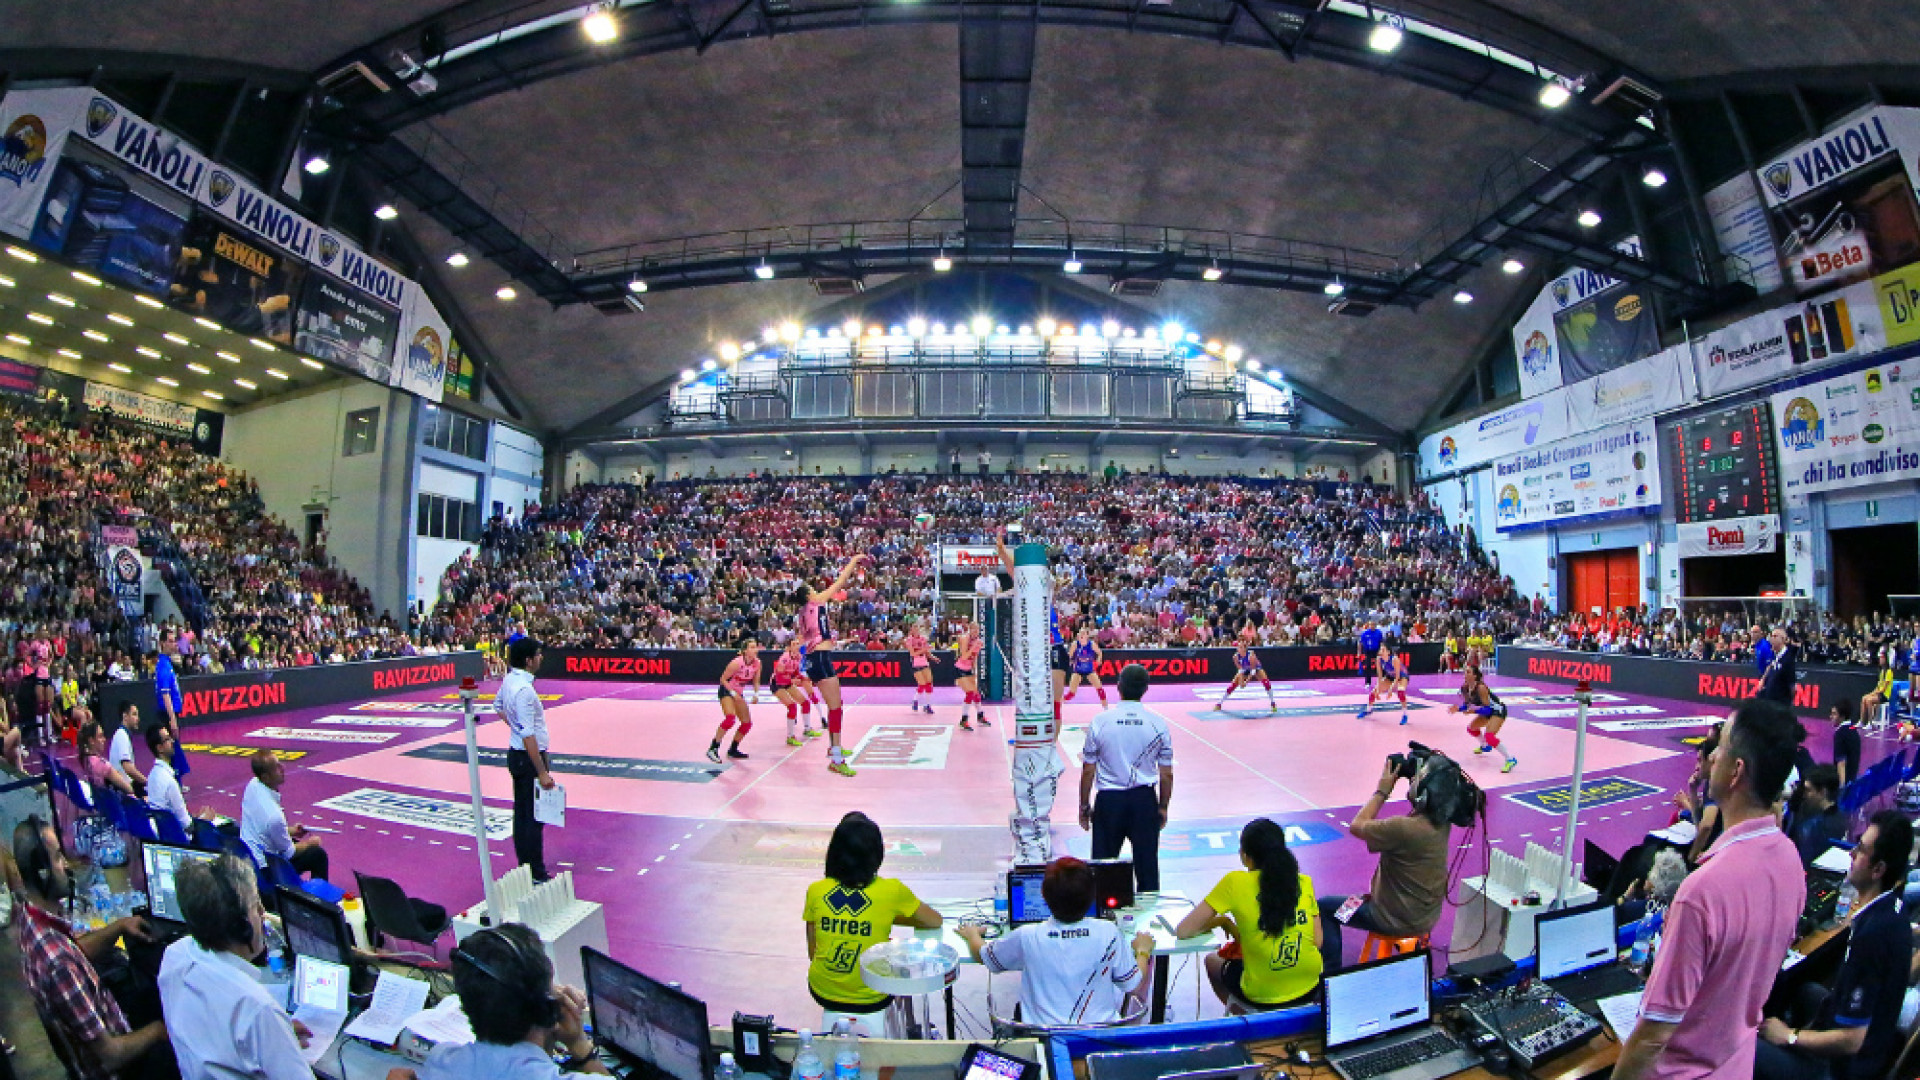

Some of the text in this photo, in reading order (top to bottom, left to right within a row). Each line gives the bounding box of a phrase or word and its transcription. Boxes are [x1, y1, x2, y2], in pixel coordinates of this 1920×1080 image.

[115, 116, 203, 194] VANOLI
[1793, 114, 1890, 187] VANOLI
[235, 187, 312, 255] VANOLI
[342, 248, 404, 300] VANOLI
[1815, 244, 1863, 276] Beta
[1804, 446, 1919, 484] chi ha condiviso
[373, 662, 455, 691] RAVIZZONI
[565, 656, 671, 675] RAVIZZONI
[1528, 657, 1612, 683] RAVIZZONI
[179, 682, 286, 718] AVIZZONI
[821, 916, 872, 937] errea
[1061, 928, 1089, 939] errea
